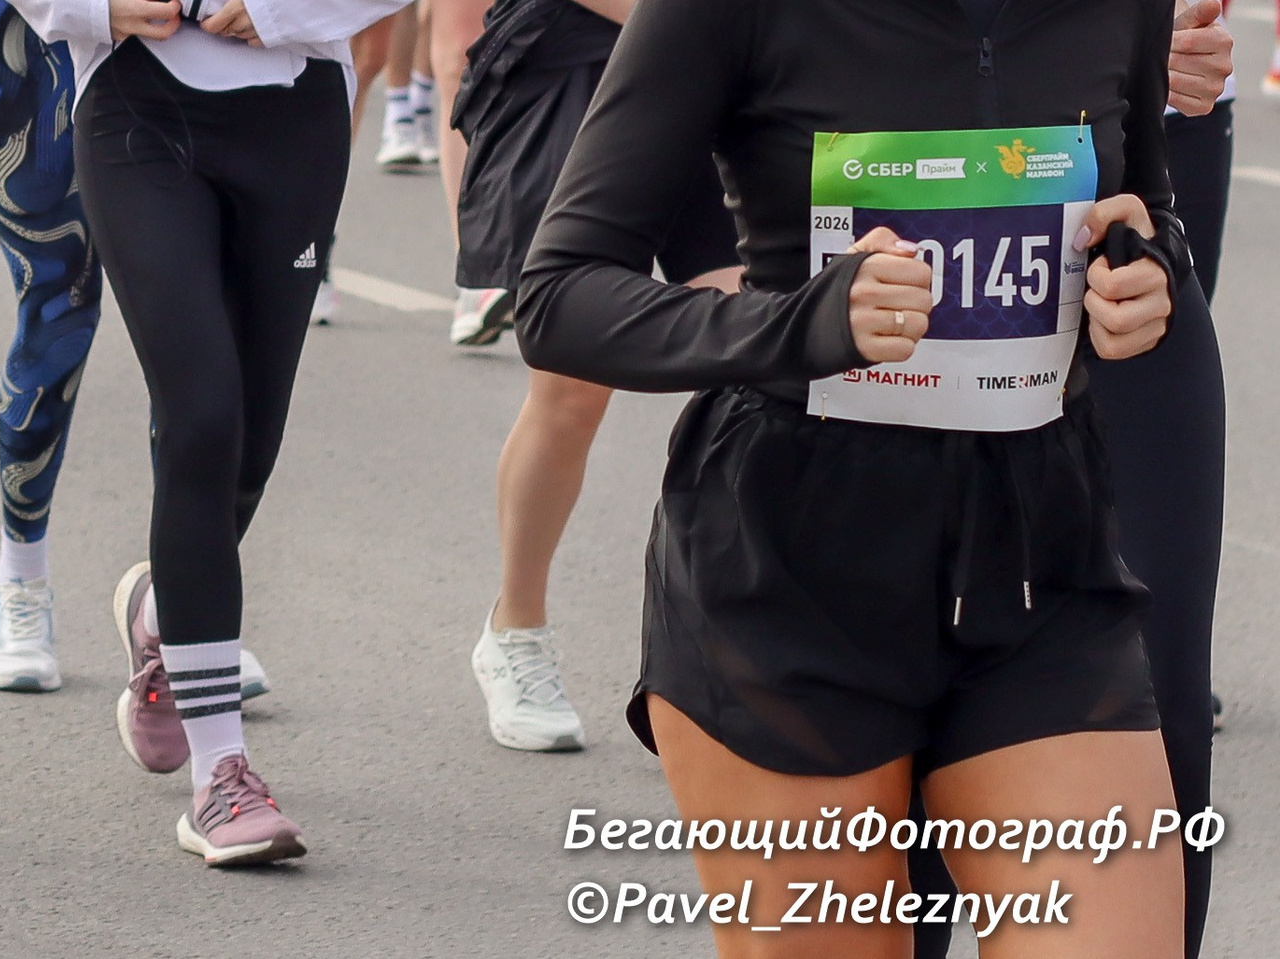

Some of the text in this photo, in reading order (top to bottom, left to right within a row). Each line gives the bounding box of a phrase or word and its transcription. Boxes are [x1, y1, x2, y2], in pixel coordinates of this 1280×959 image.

[867, 163, 914, 177] СБЕР
[921, 163, 956, 176] Прайм
[1026, 159, 1074, 170] КАЗАНСКИЙ
[1026, 169, 1065, 178] МАРАФОН
[814, 216, 850, 230] 2026
[917, 235, 1050, 308] 0145
[866, 369, 941, 388] МАГНИТ
